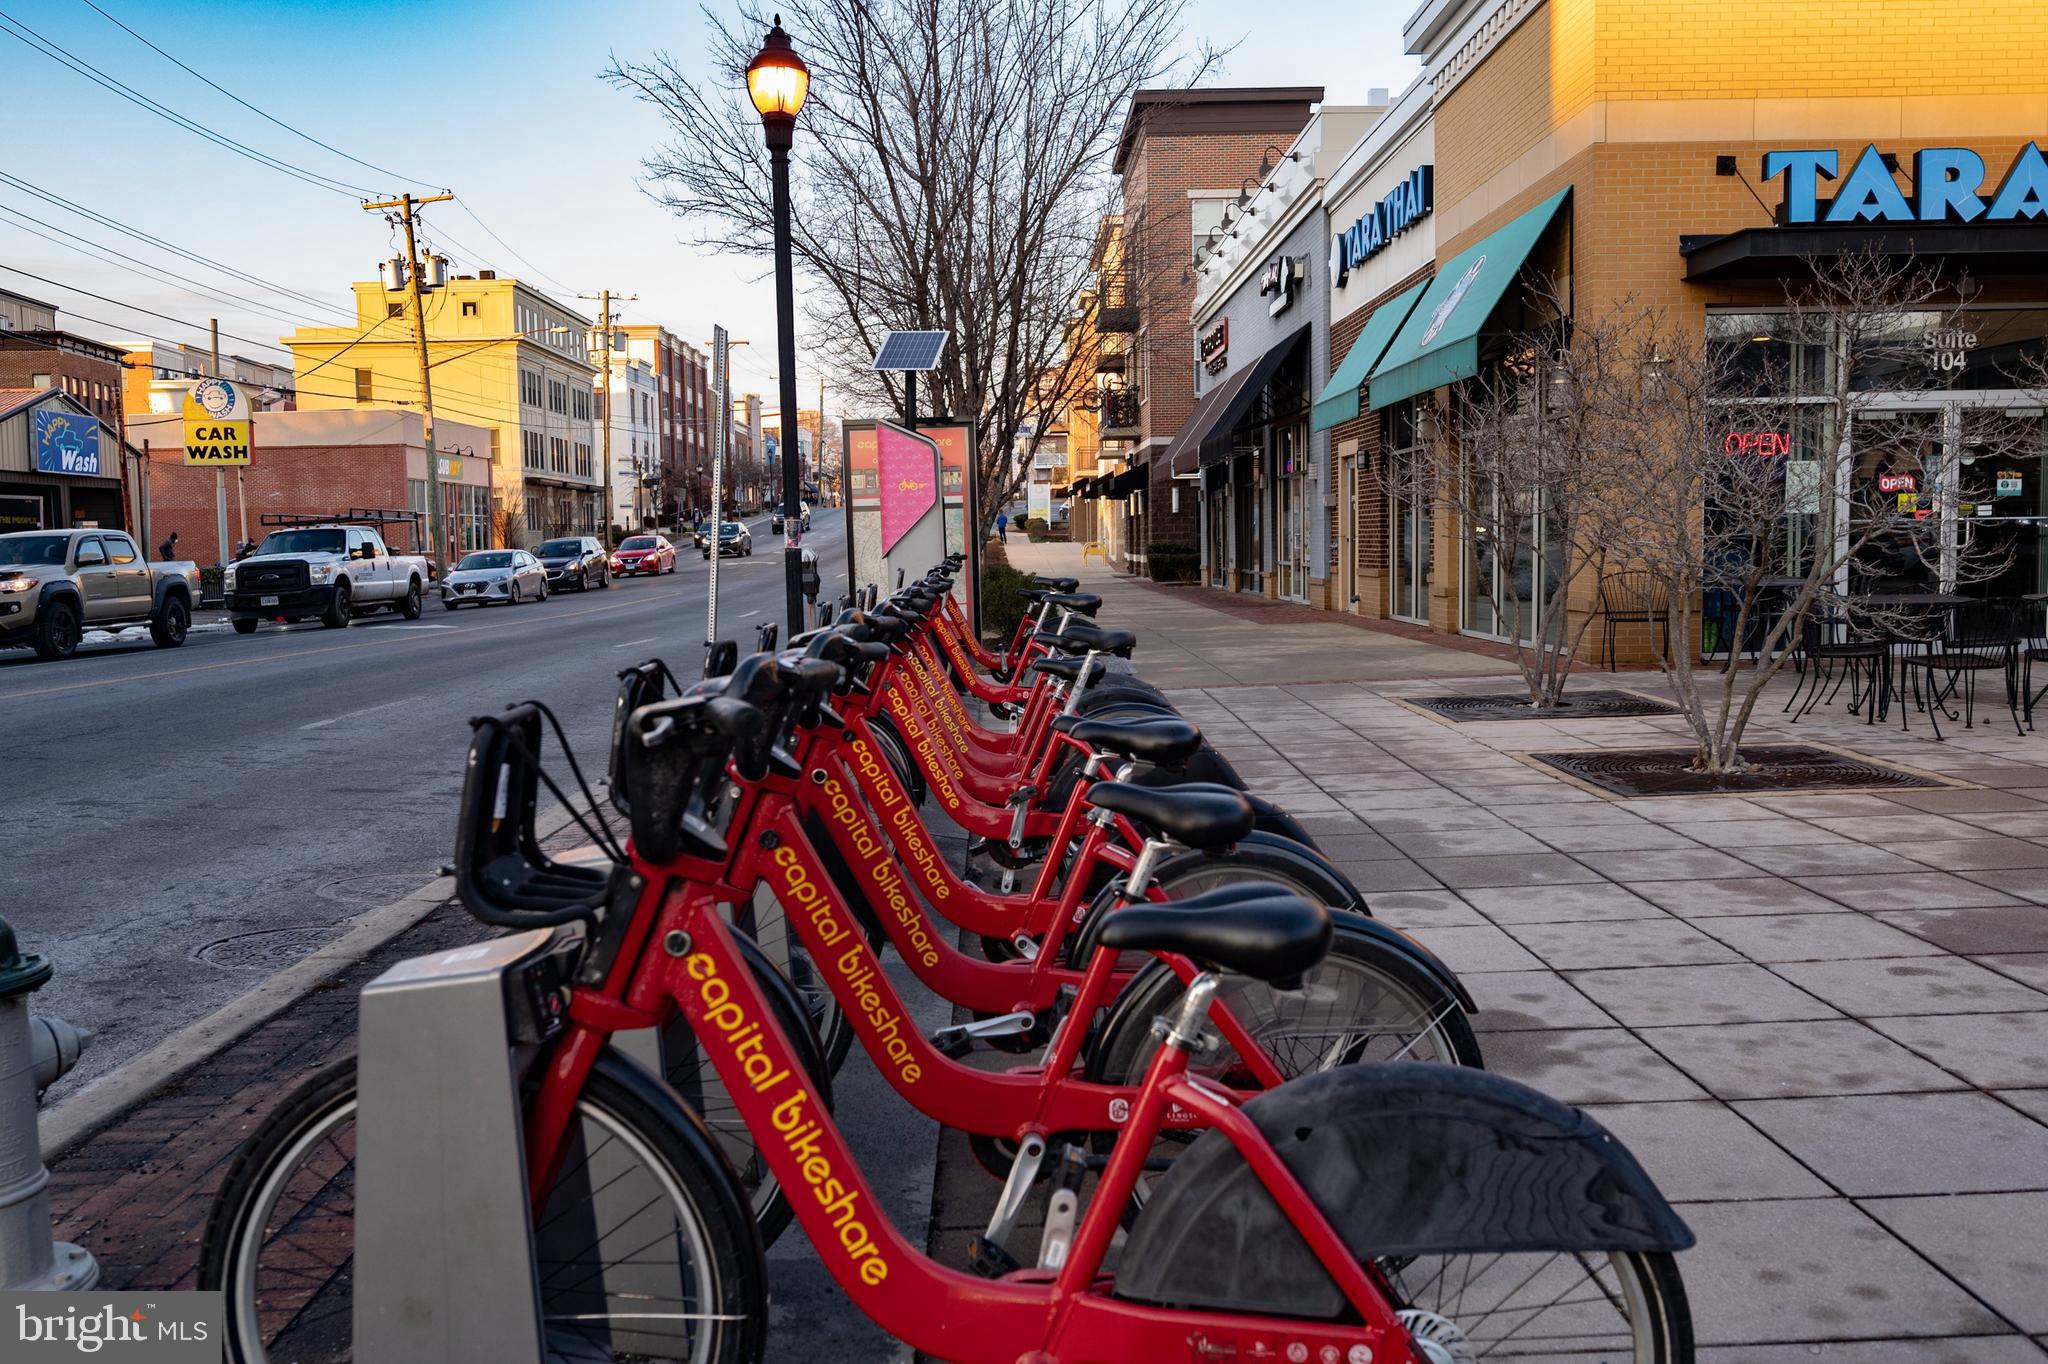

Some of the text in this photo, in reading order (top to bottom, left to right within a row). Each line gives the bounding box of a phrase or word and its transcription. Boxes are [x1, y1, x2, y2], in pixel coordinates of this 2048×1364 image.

[1762, 140, 2048, 224] TARA
[1345, 165, 1433, 268] TARA THAI
[1923, 329, 1977, 349] Suite
[1931, 351, 1966, 371] 104
[196, 378, 224, 395] HAPPY
[42, 417, 70, 446] HAPPY
[61, 450, 98, 473] Wash
[187, 445, 248, 459] WASH
[195, 427, 237, 440] CAR
[1724, 431, 1791, 456] OPEN
[1881, 476, 1913, 489] OPEN
[935, 617, 977, 687] capital bikeshare
[900, 671, 964, 780] capital bikeshare
[911, 656, 969, 754] capital bikeshare
[940, 680, 972, 733] bikeshare
[887, 687, 960, 809] capital bikeshare
[852, 739, 950, 900] capital bikeshare
[823, 778, 939, 968] capital bikeshare
[774, 845, 922, 1085] capital bikeshare
[686, 951, 889, 1287] capital bikeshare
